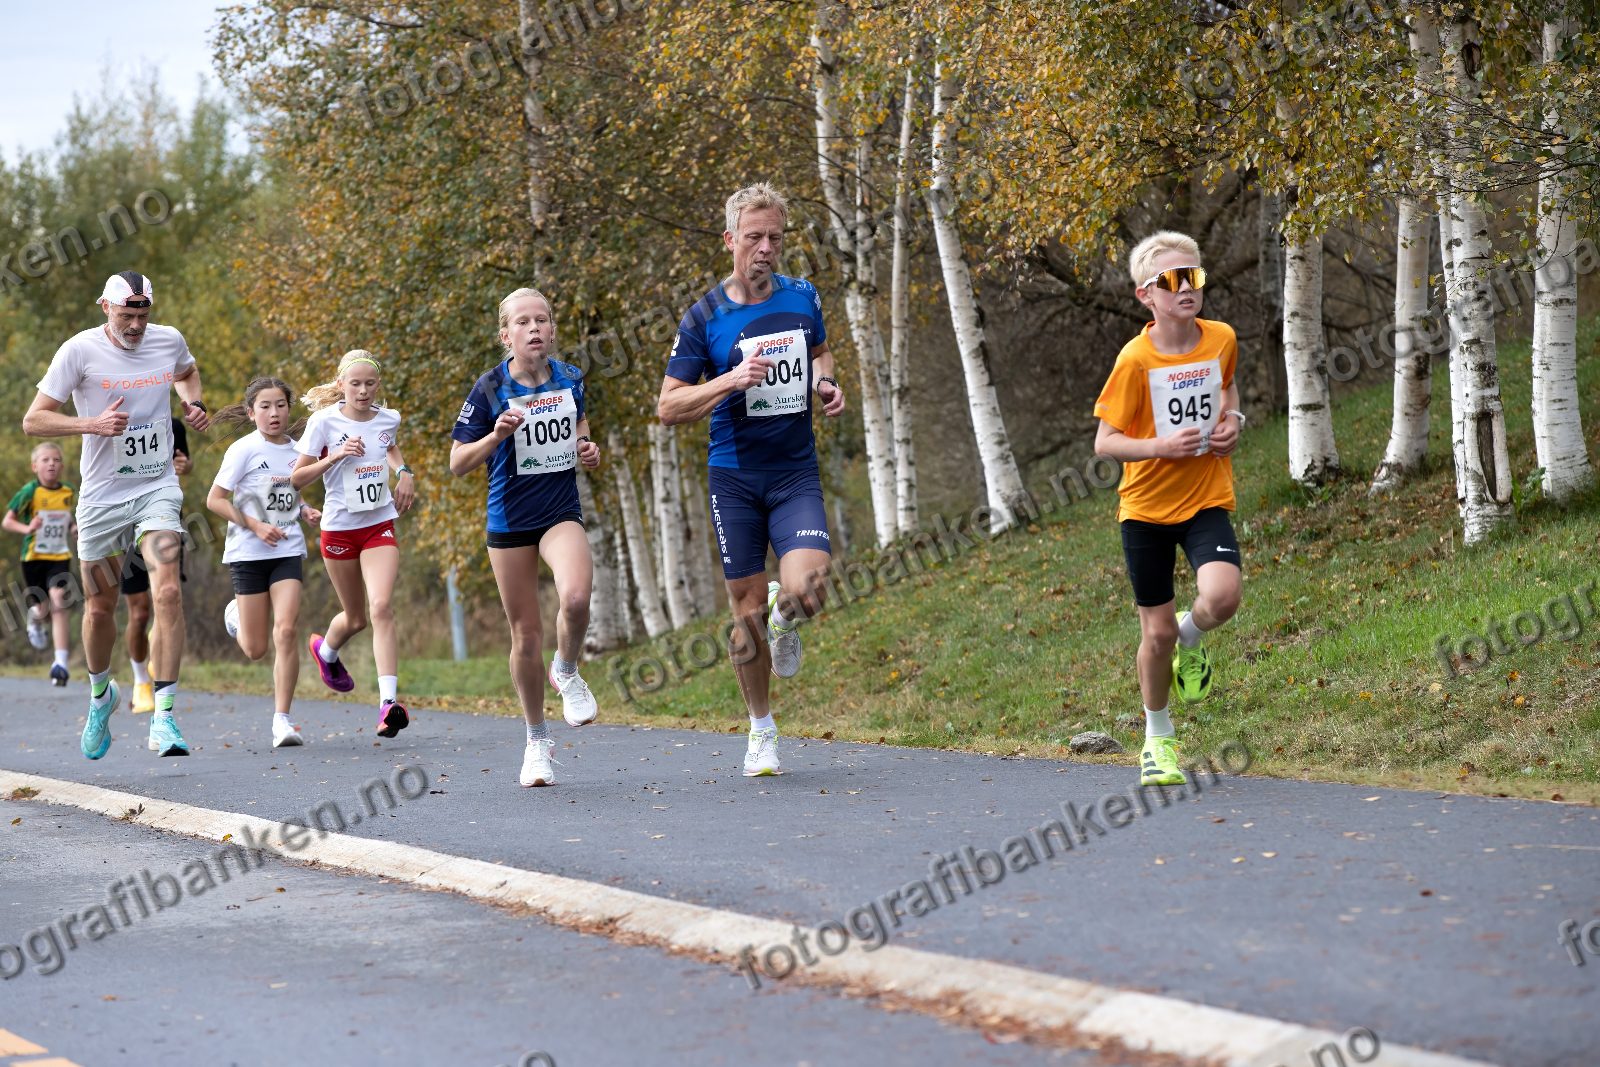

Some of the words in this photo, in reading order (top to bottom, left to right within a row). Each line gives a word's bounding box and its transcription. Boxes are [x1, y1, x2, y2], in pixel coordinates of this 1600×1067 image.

[757, 358, 803, 388] 004
[1168, 368, 1211, 382] NORGES
[1173, 378, 1205, 390] LØPET
[526, 396, 563, 408] NORGES
[530, 404, 558, 416] LØPET
[1168, 393, 1211, 425] 945
[522, 417, 572, 446] 1003
[125, 432, 158, 456] 314
[355, 465, 383, 474] NORGES
[358, 472, 380, 480] LØPET
[356, 483, 383, 503] 107
[266, 493, 293, 511] 259
